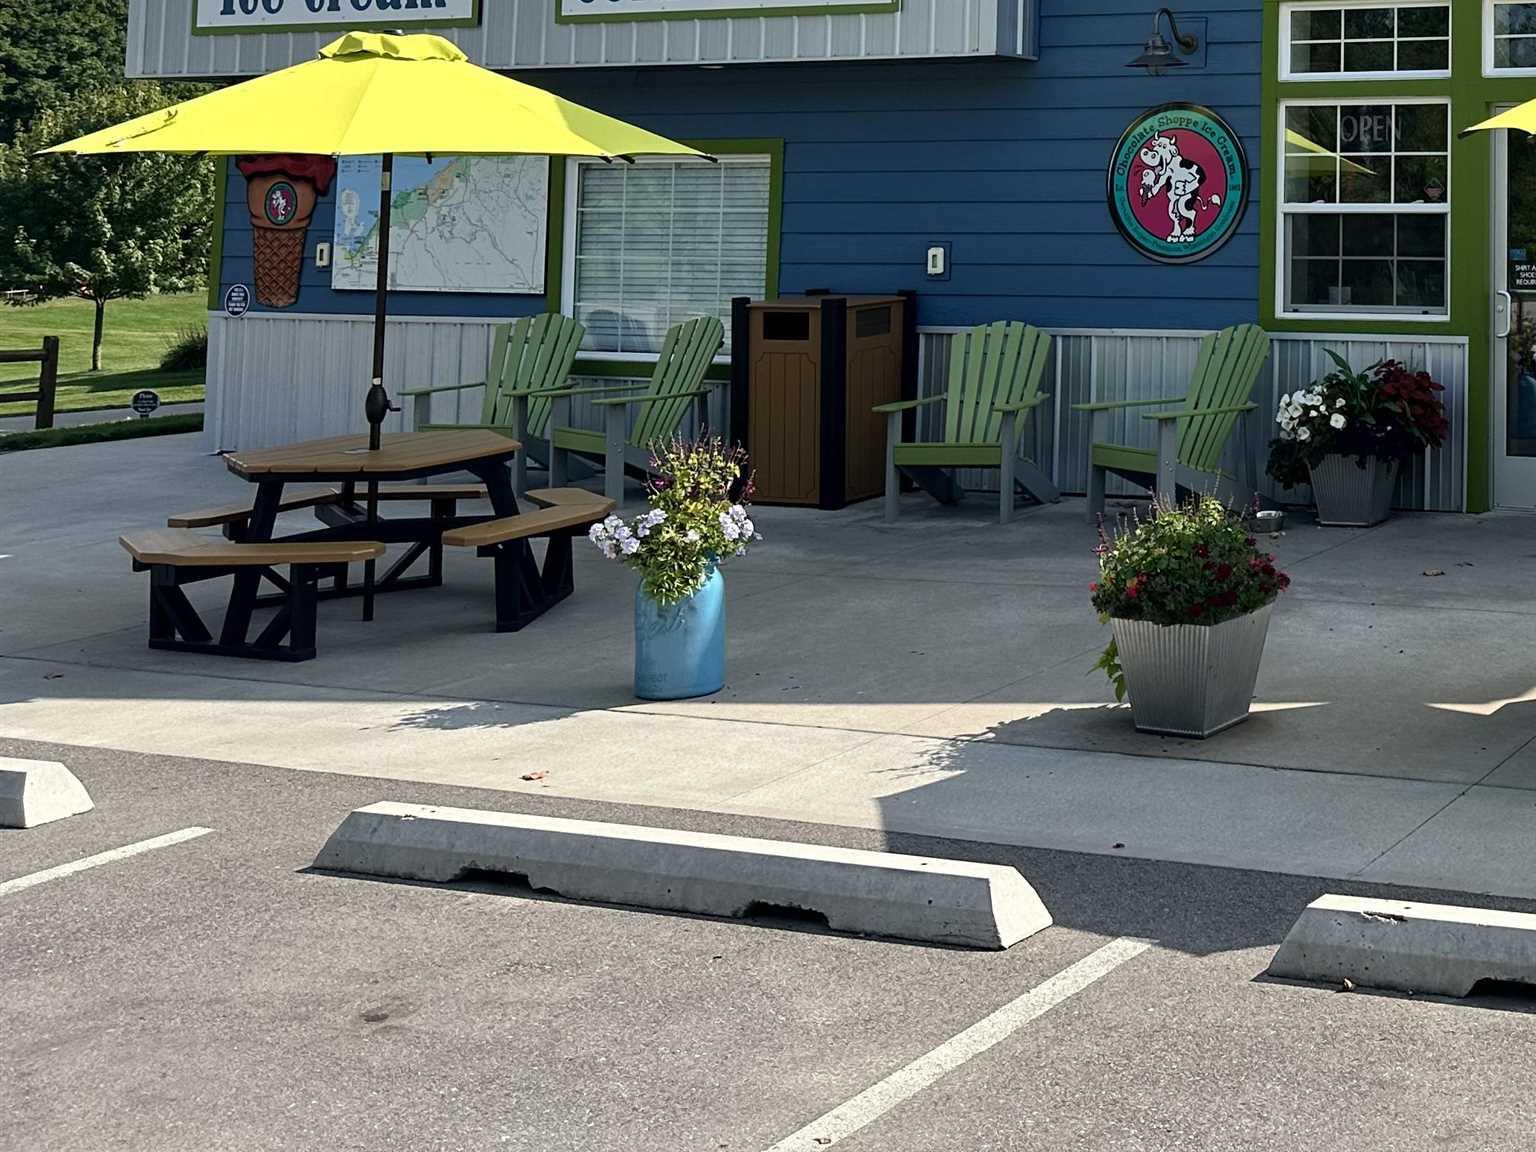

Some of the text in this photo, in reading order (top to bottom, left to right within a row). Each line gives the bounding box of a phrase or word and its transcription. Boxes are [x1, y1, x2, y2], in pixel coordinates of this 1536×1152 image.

[1116, 115, 1236, 177] Chocolate Shoppe Ice Cream
[1341, 115, 1401, 142] OPEN
